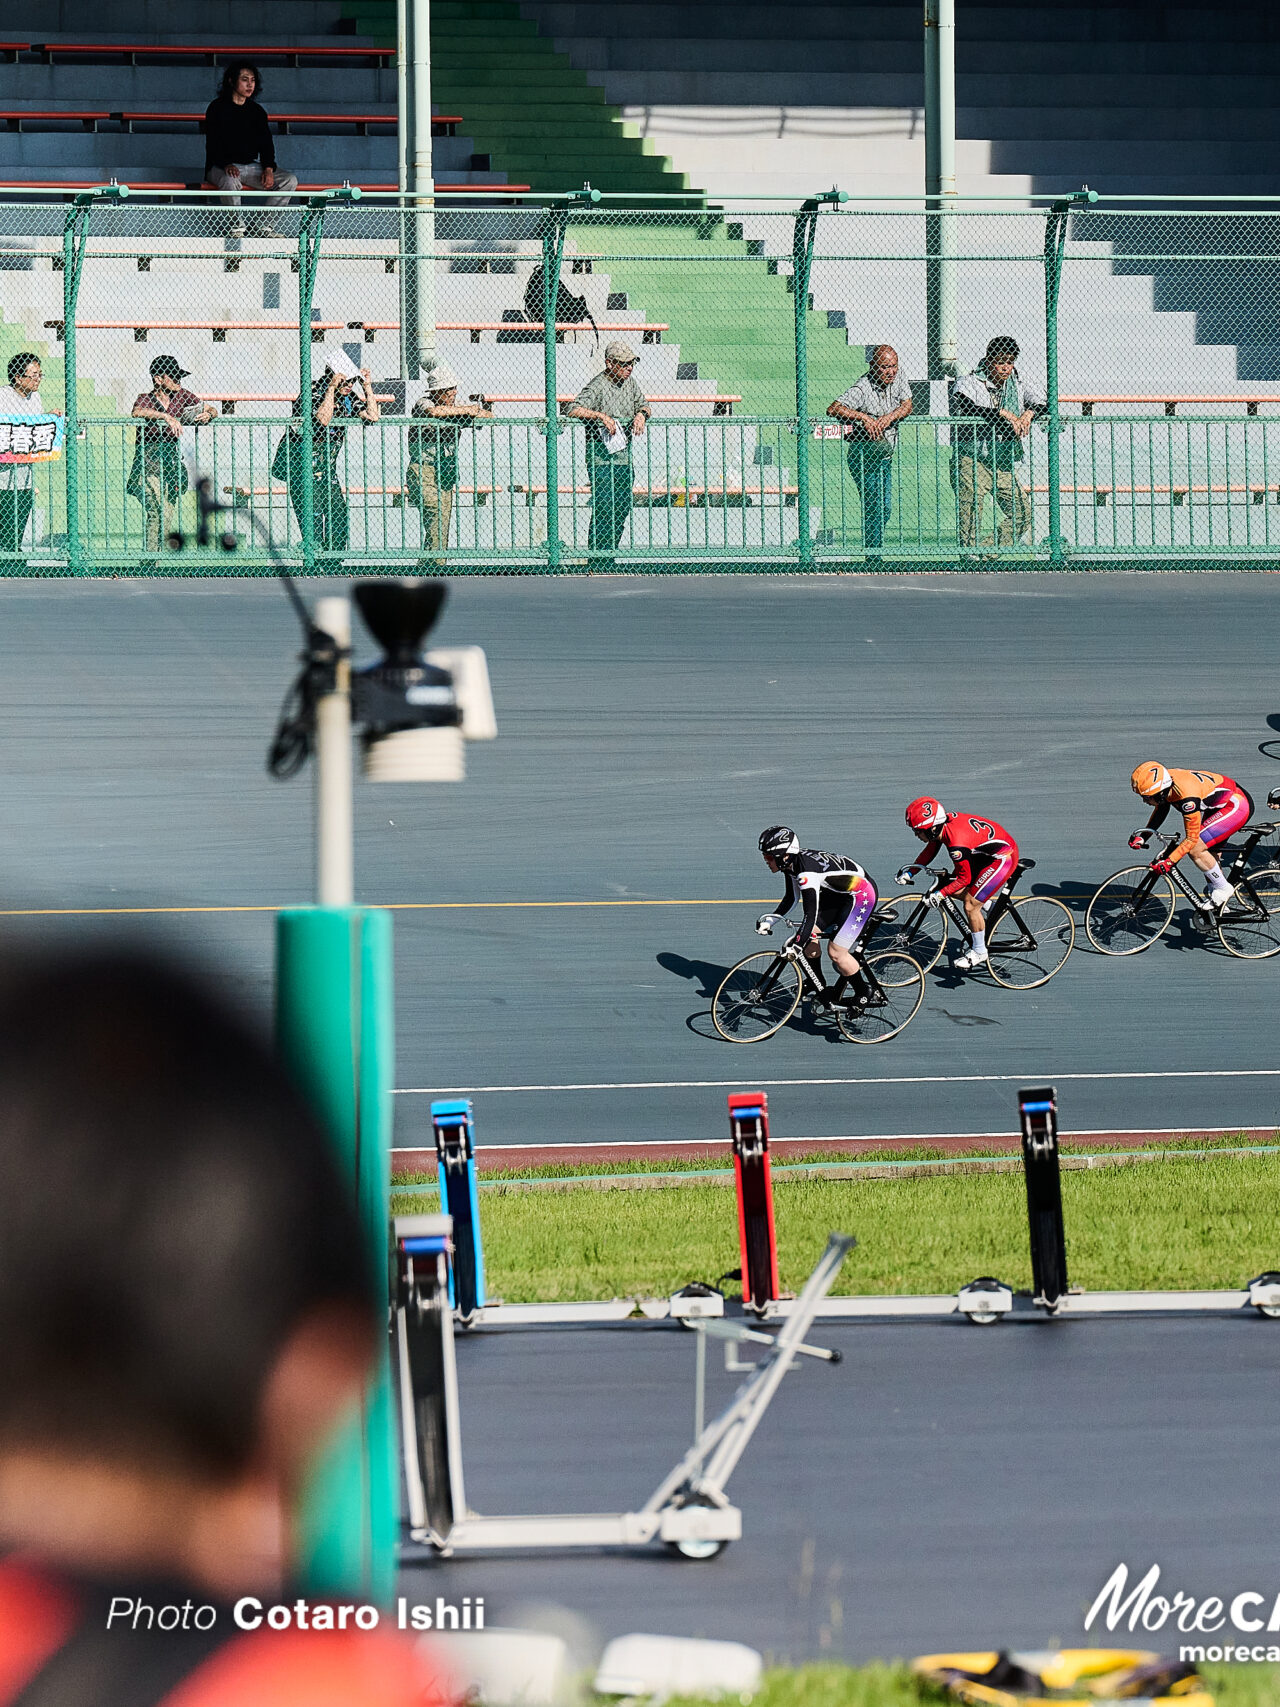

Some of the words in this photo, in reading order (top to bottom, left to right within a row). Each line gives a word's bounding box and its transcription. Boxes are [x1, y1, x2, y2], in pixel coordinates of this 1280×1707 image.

[1149, 767, 1159, 783] 7
[921, 802, 933, 818] 3
[778, 828, 790, 842] 2
[968, 818, 996, 841] 3
[974, 866, 995, 888] KEIRIN
[944, 895, 972, 935] RIDGESTONE
